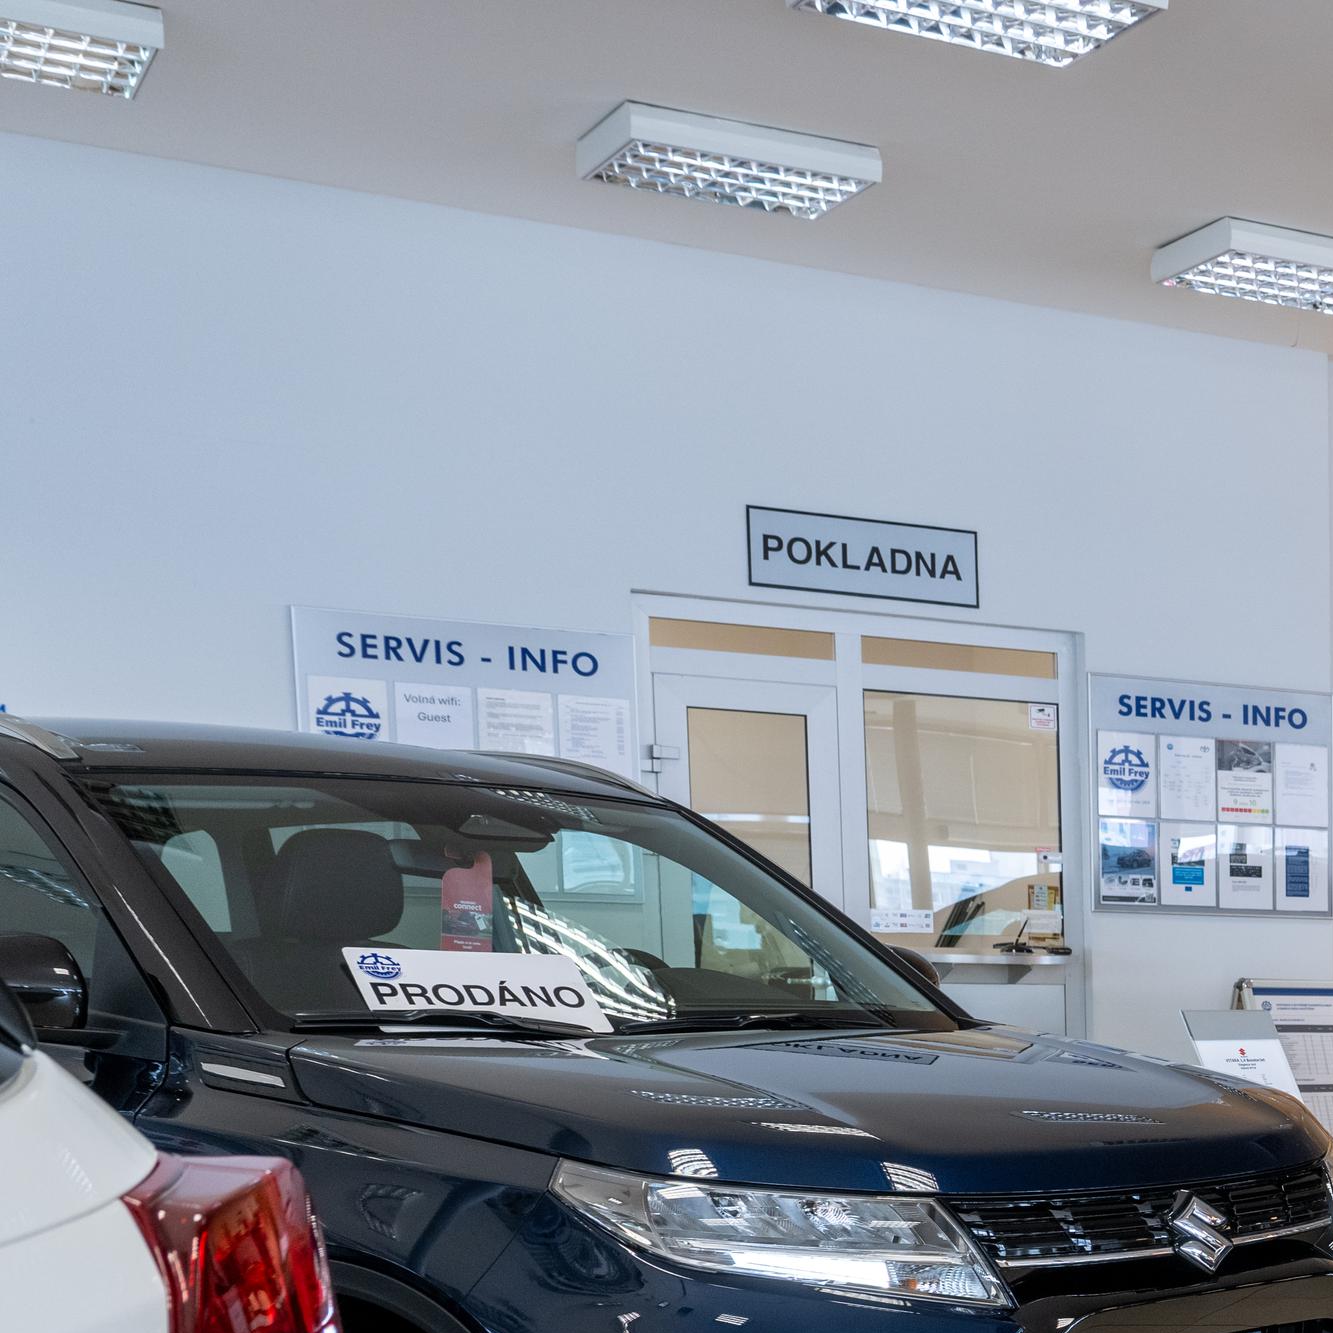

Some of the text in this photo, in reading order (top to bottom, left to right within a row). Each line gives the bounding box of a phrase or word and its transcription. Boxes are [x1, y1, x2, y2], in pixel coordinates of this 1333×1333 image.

[762, 534, 962, 581] POKLADNA
[336, 632, 465, 666] SERVIS
[508, 646, 599, 677] INFO
[404, 693, 461, 707] Volná wifi:
[417, 711, 451, 724] Guest
[1118, 694, 1212, 722] SERVIS
[1243, 704, 1308, 729] INFO
[316, 717, 381, 733] Emil Frey
[1104, 766, 1150, 780] Emil Frey
[453, 903, 482, 912] connect
[359, 964, 379, 972] Emil
[369, 980, 586, 1009] PRODÁNO
